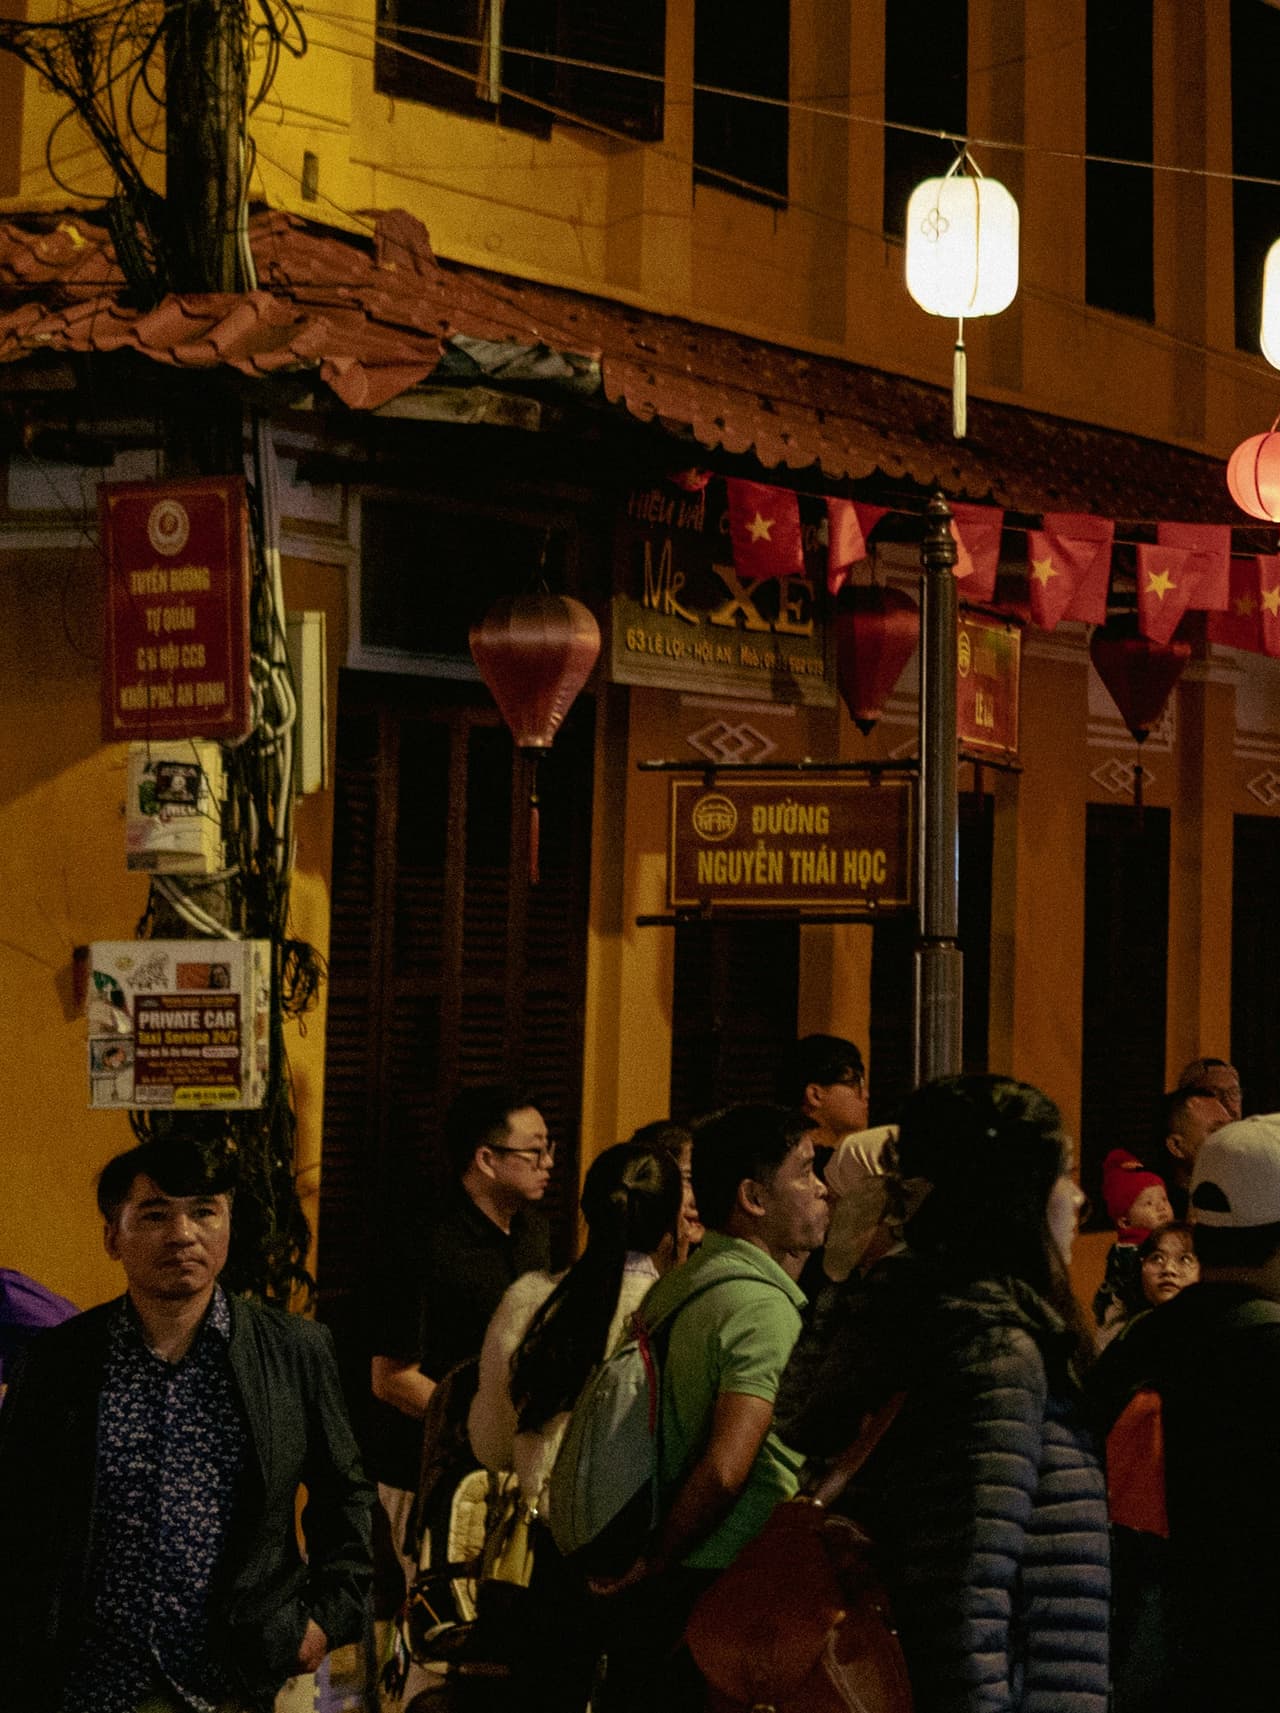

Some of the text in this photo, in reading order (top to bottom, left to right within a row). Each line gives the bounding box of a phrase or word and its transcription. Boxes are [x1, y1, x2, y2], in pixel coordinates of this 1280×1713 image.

[709, 563, 814, 637] XE
[627, 628, 645, 652] 63
[647, 632, 664, 655] LÊ
[715, 643, 732, 664] AN
[752, 798, 830, 835] ĐƯỜNG
[697, 839, 887, 890] NGUYỄN THÁI HỌC
[138, 1010, 235, 1029] PRIVATE CAR
